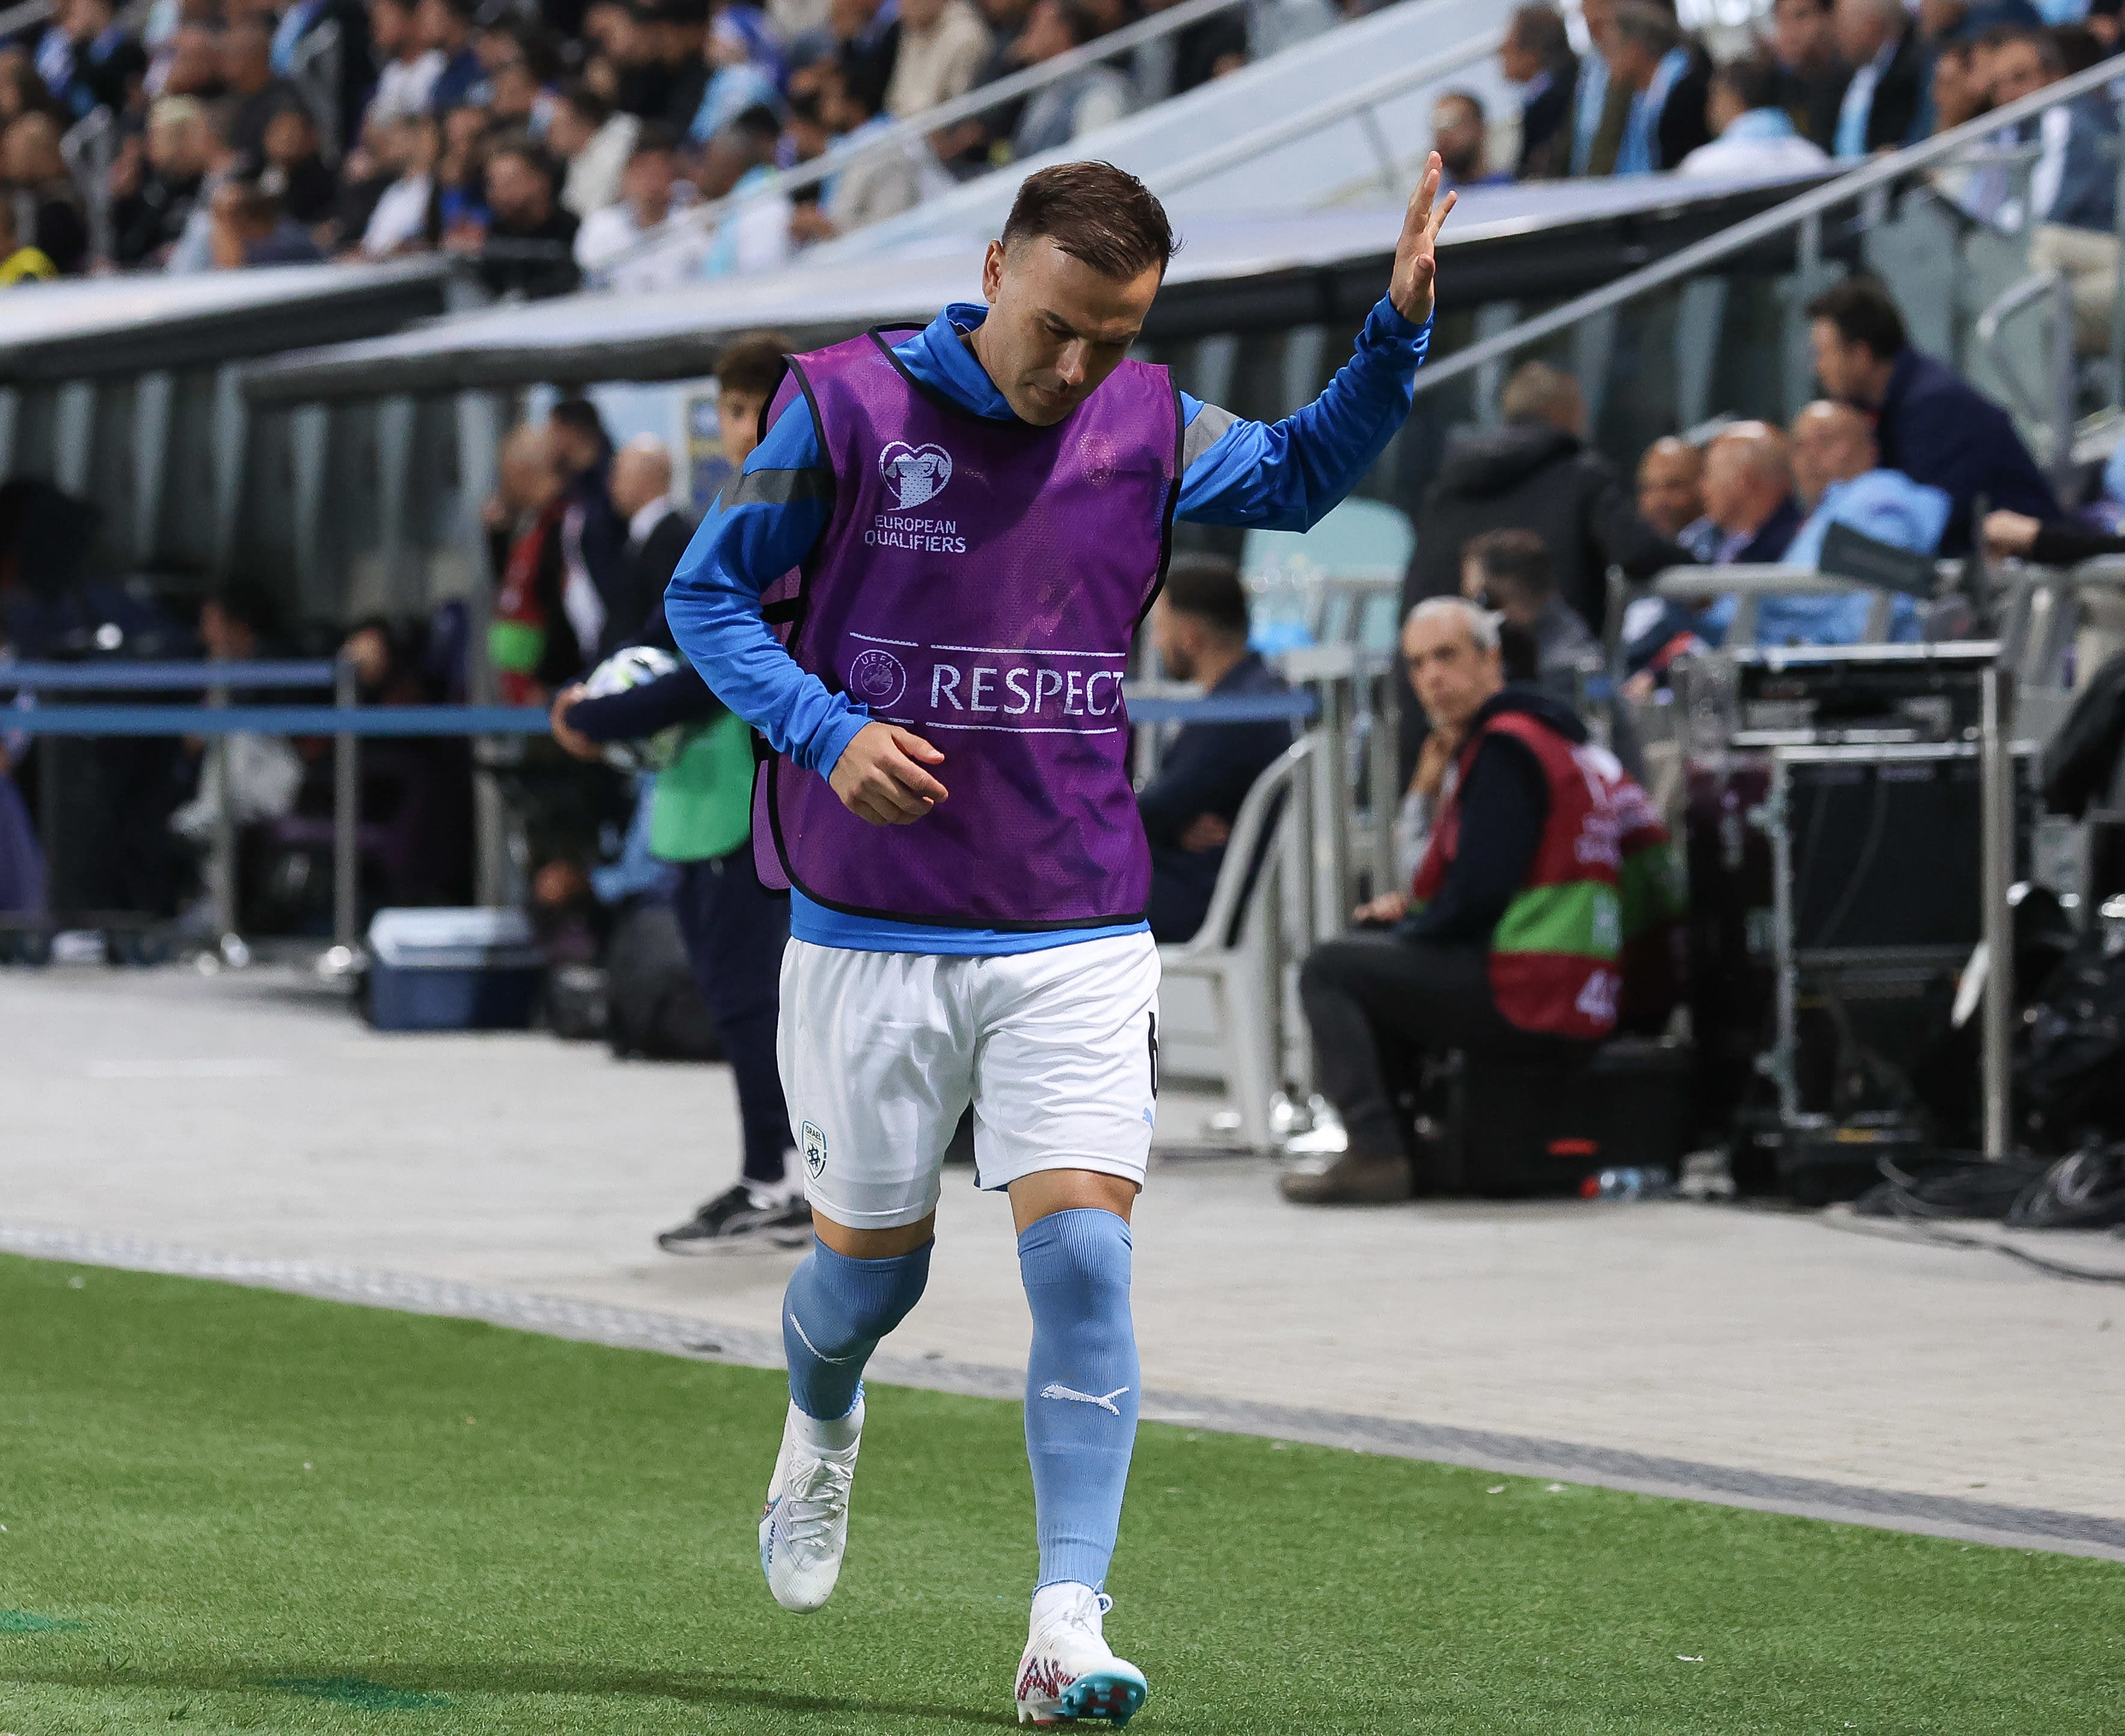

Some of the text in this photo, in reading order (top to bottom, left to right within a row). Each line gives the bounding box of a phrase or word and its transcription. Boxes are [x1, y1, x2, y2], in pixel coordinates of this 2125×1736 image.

[875, 515, 956, 534] EUROPEAN
[864, 530, 967, 553] QUALIFIERS
[861, 653, 893, 669] UEFA
[930, 663, 1124, 716] RESPECT
[805, 1125, 822, 1141] ISRAEL
